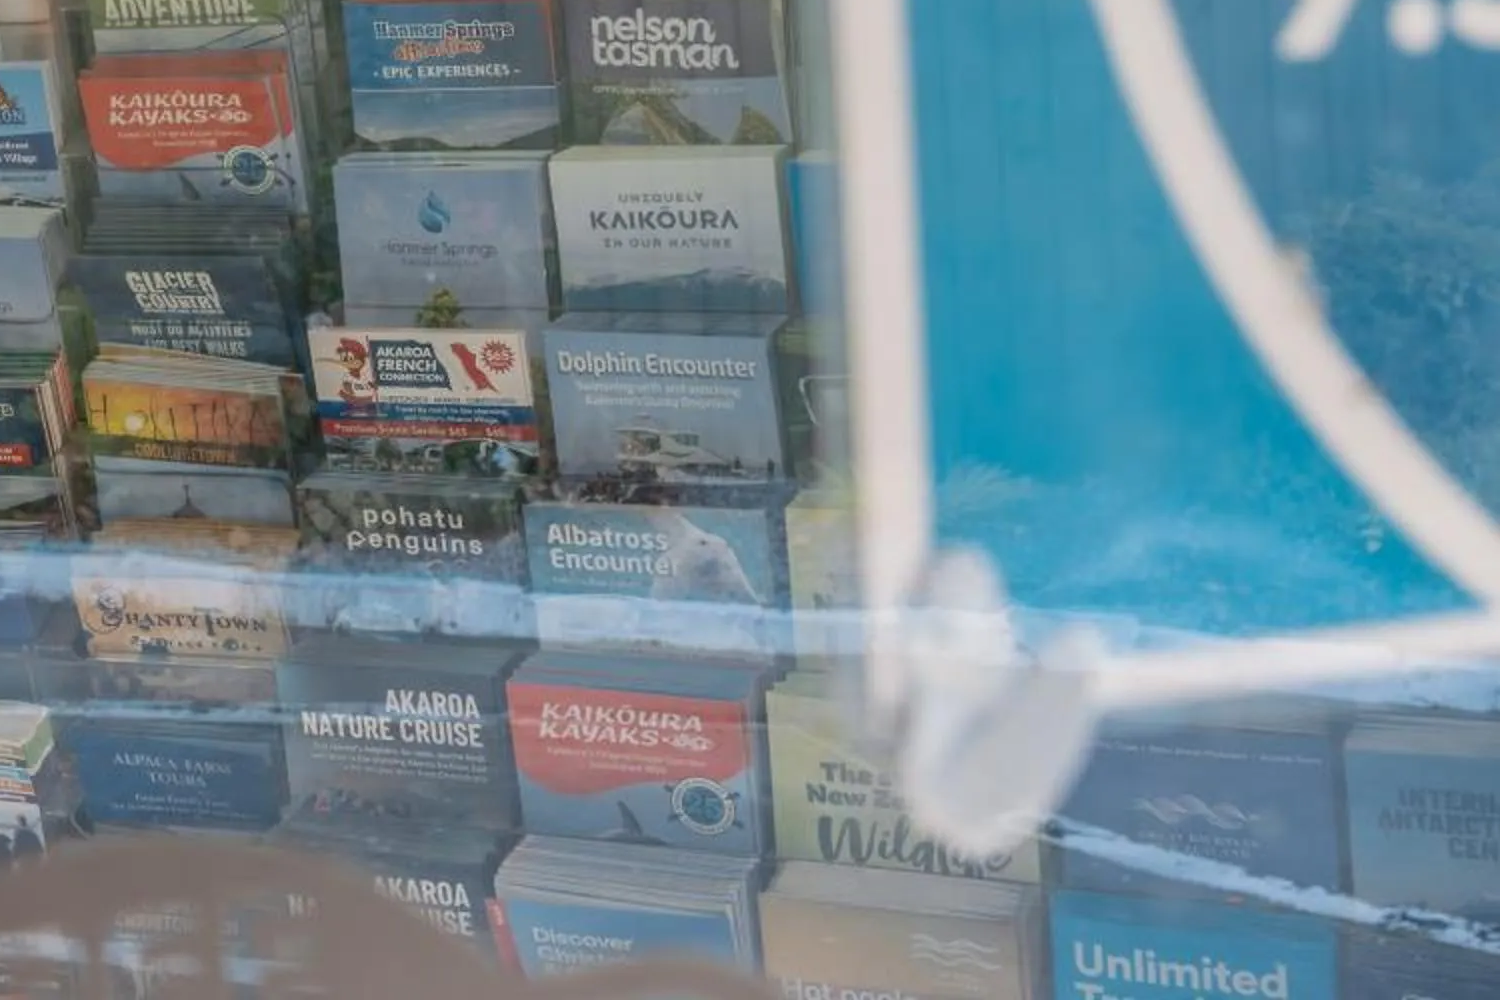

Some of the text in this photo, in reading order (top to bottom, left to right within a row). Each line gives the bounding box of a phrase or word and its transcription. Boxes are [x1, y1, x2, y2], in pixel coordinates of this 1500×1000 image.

[591, 8, 716, 44] nelson
[592, 40, 739, 71] tasman
[417, 63, 510, 78] EXPERIENCES
[590, 204, 739, 230] KAIKŌURA
[442, 240, 497, 259] Springs
[125, 271, 214, 293] GLACIER
[134, 291, 224, 311] COUNTRY
[376, 346, 432, 358] AKAROA
[558, 351, 757, 378] Dolphin Encounter
[376, 358, 437, 373] FRENCH
[363, 507, 463, 530] pohatu
[547, 524, 668, 551] Albatross
[550, 548, 679, 577] Encounter
[385, 689, 481, 720] AKAROA
[542, 702, 703, 731] KAIKŌURA
[301, 711, 484, 748] NATURE CRUISE
[819, 761, 873, 786] The
[806, 783, 866, 807] New
[375, 876, 471, 908] AKAROA
[532, 926, 634, 950] Discover
[1074, 940, 1289, 999] Unlimited
